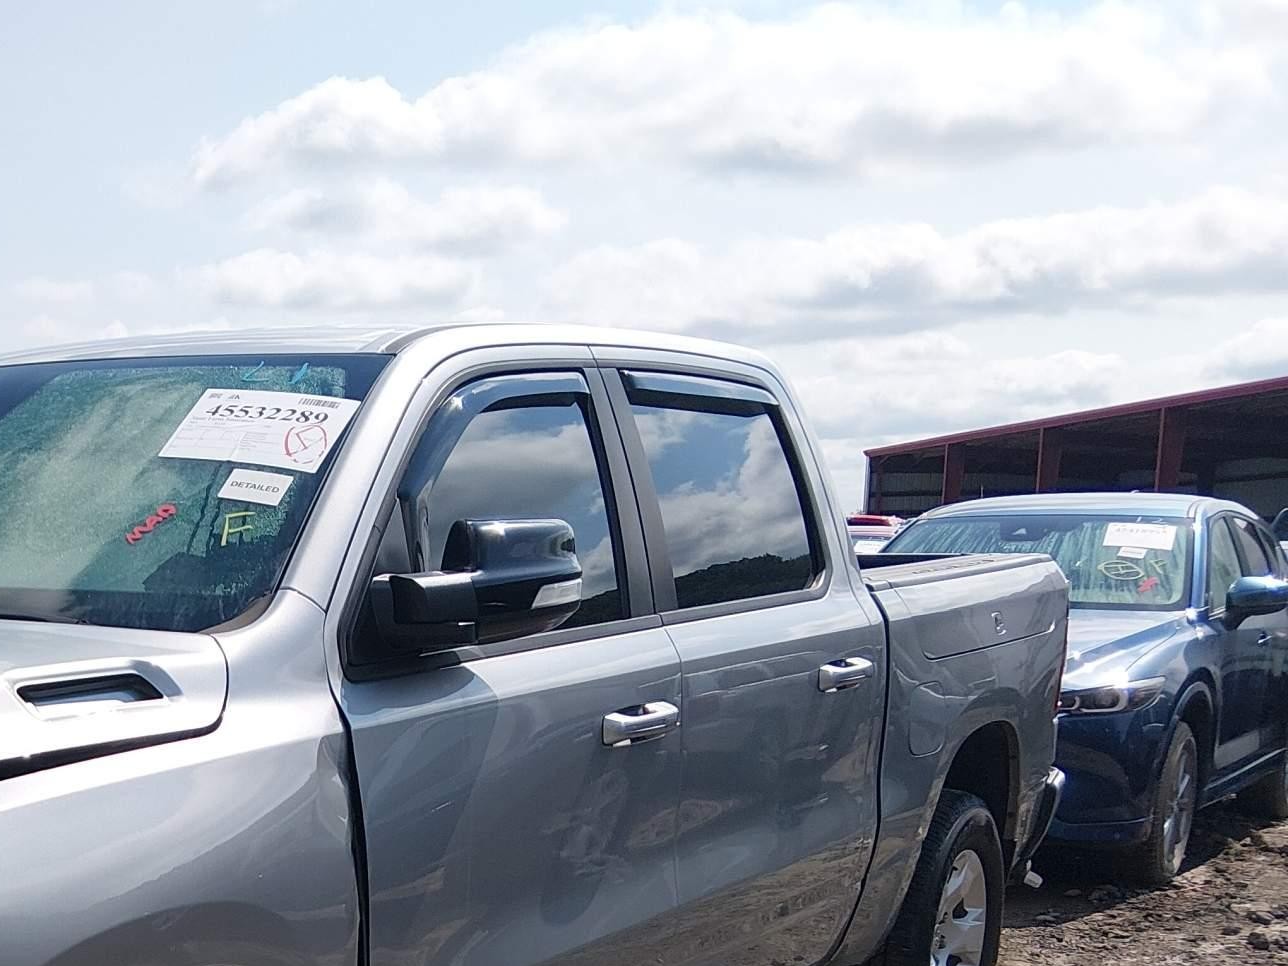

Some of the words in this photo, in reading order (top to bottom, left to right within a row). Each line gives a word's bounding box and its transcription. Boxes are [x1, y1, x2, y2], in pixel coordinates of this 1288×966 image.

[206, 404, 329, 424] 45532289
[230, 480, 280, 493] DETAILED
[220, 511, 256, 546] F
